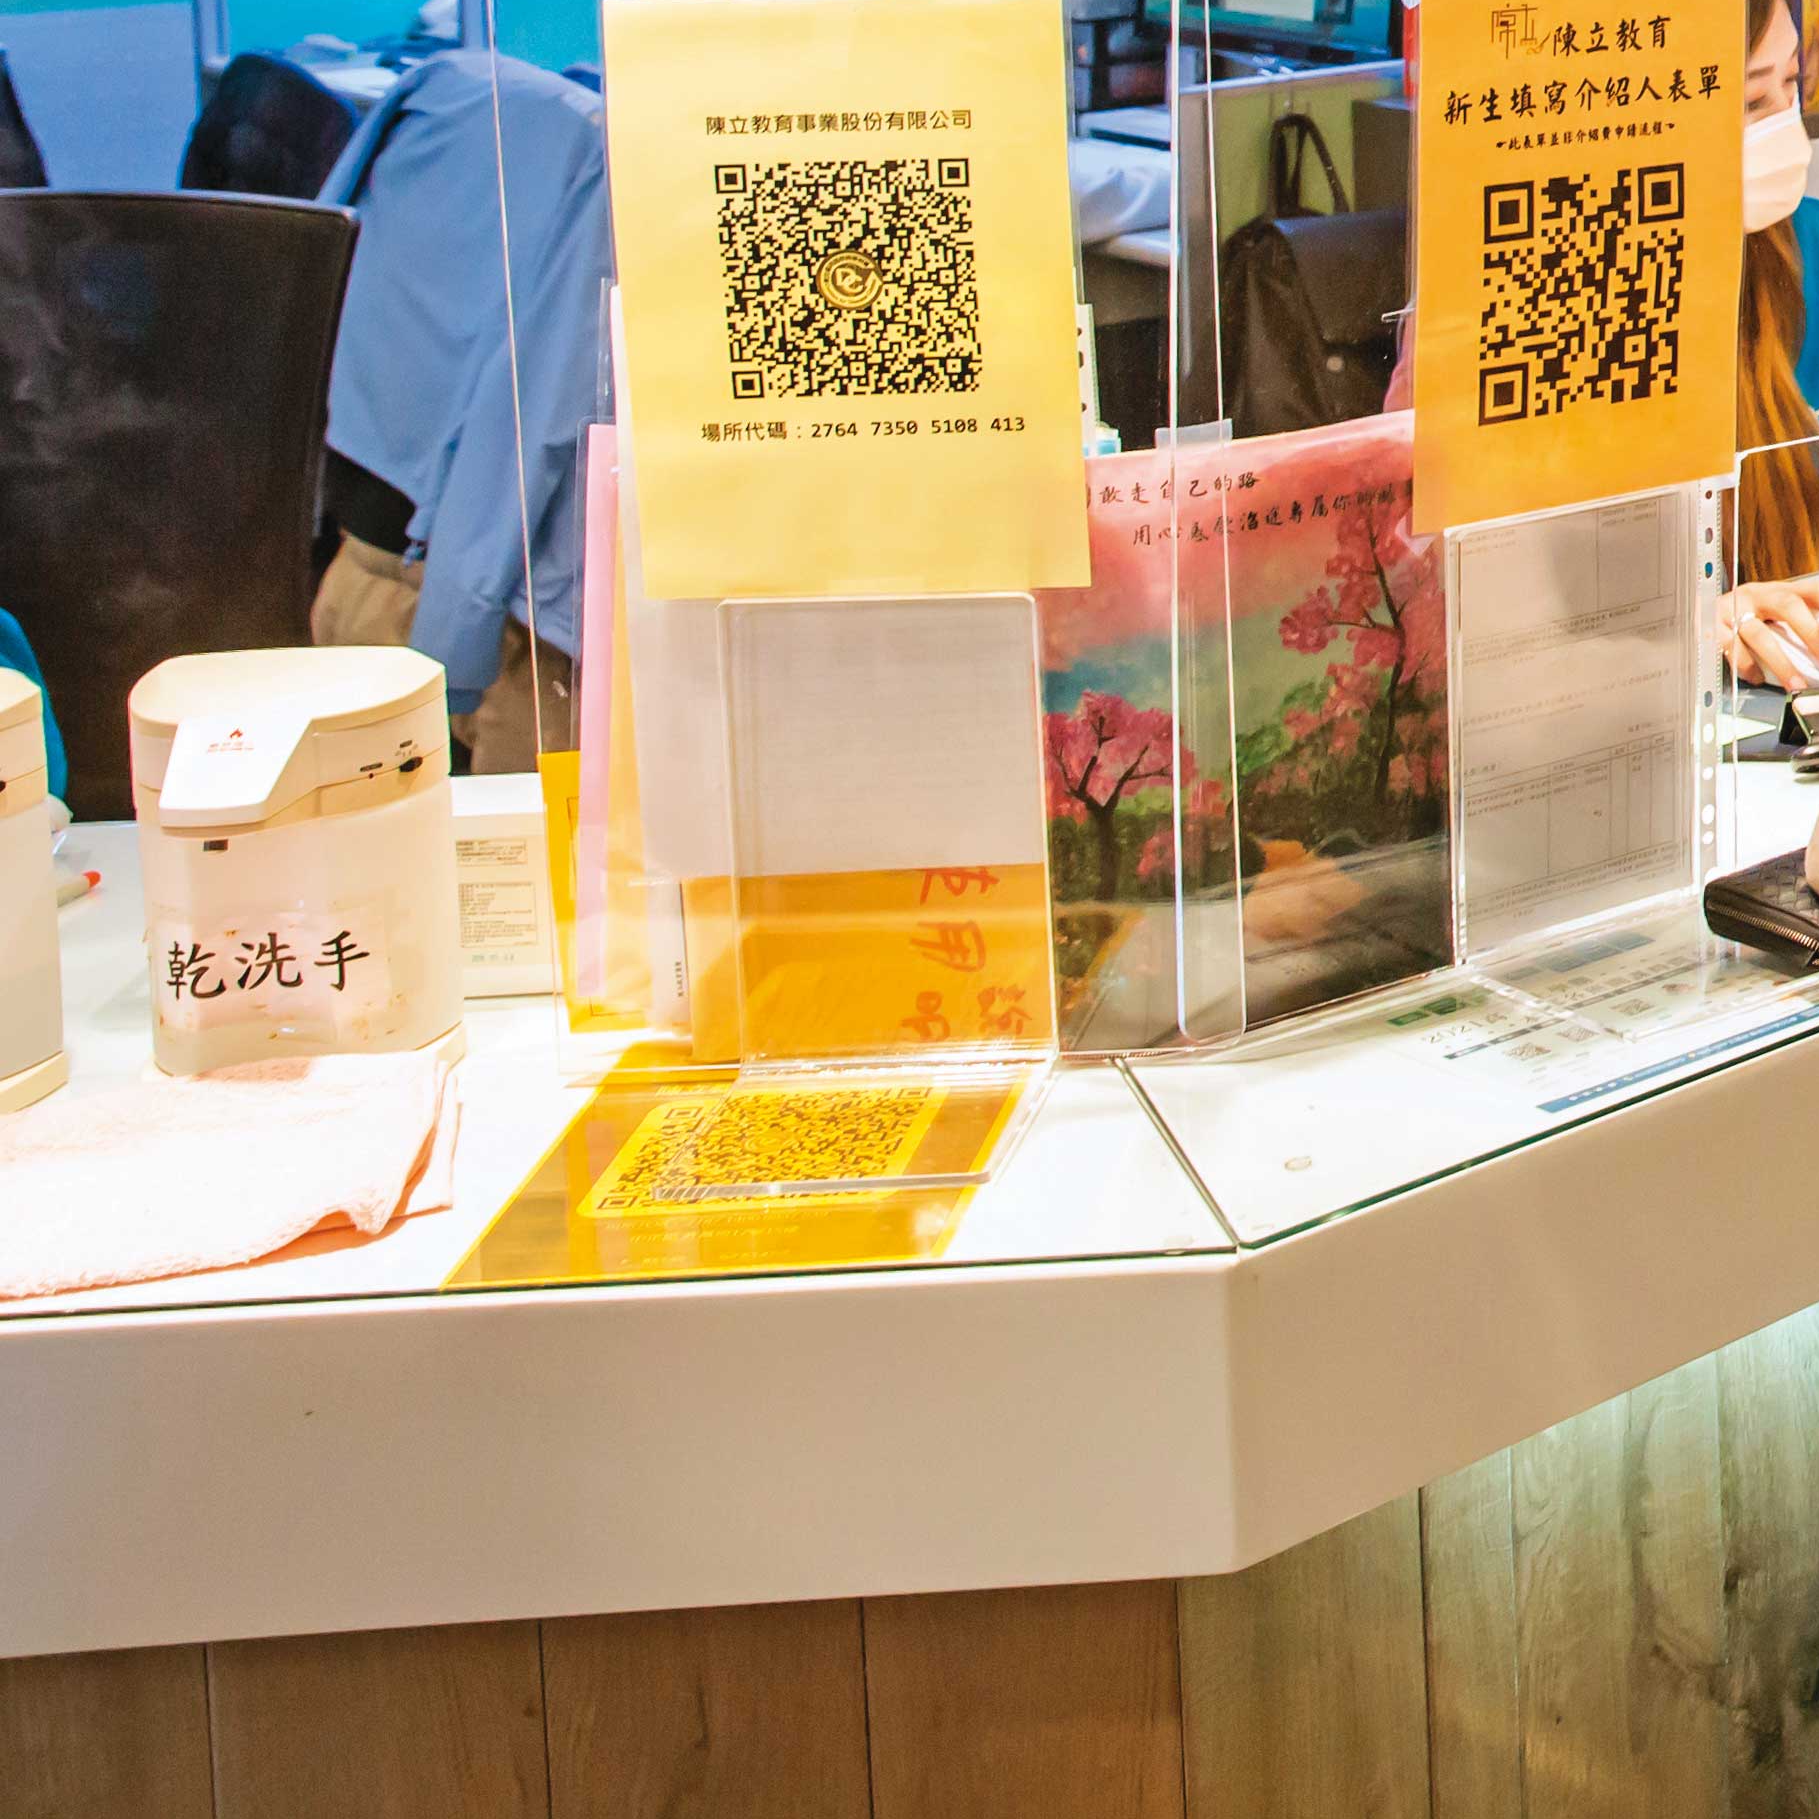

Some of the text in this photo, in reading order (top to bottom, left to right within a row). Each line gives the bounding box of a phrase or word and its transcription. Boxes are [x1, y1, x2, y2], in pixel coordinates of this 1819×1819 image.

[1551, 14, 1672, 58] 陳立教育
[1443, 64, 1722, 126] 新生填寫介紹人表單
[705, 108, 973, 137] 陳立教育事業股份有限公司
[810, 421, 859, 439] 2764
[871, 419, 919, 437] 7350
[930, 417, 978, 437] 5108
[990, 416, 1026, 434] 413
[1087, 470, 1261, 510] 敢走自己的路
[165, 928, 371, 1002] 乾洗手
